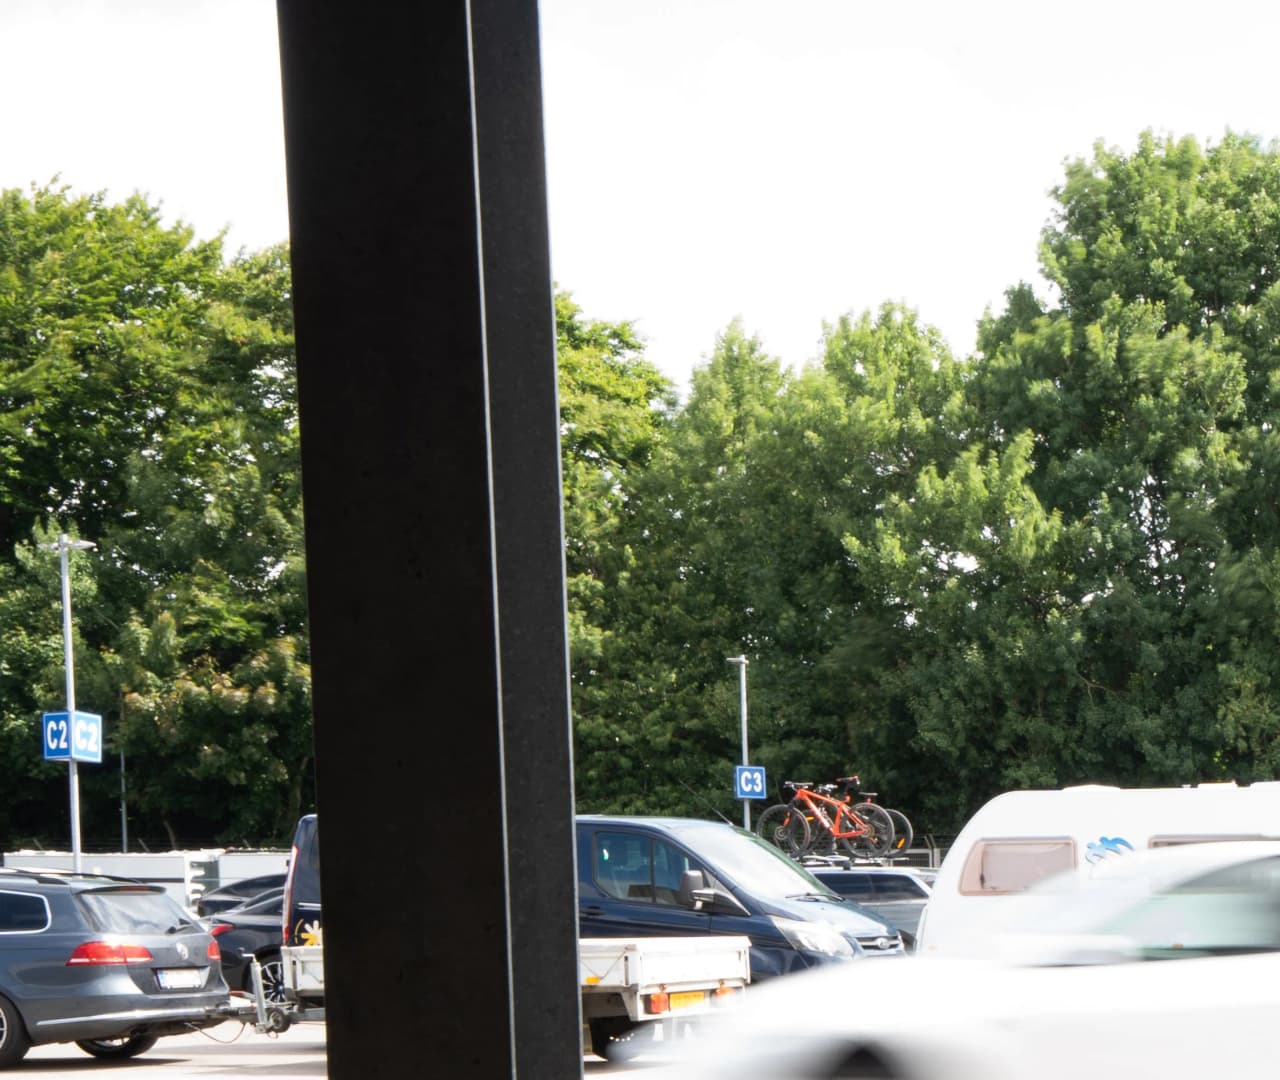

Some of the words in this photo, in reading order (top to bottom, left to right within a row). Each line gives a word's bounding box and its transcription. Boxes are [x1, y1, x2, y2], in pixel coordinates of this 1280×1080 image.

[47, 720, 68, 750] C2
[75, 720, 98, 753] C2
[740, 771, 762, 793] C3
